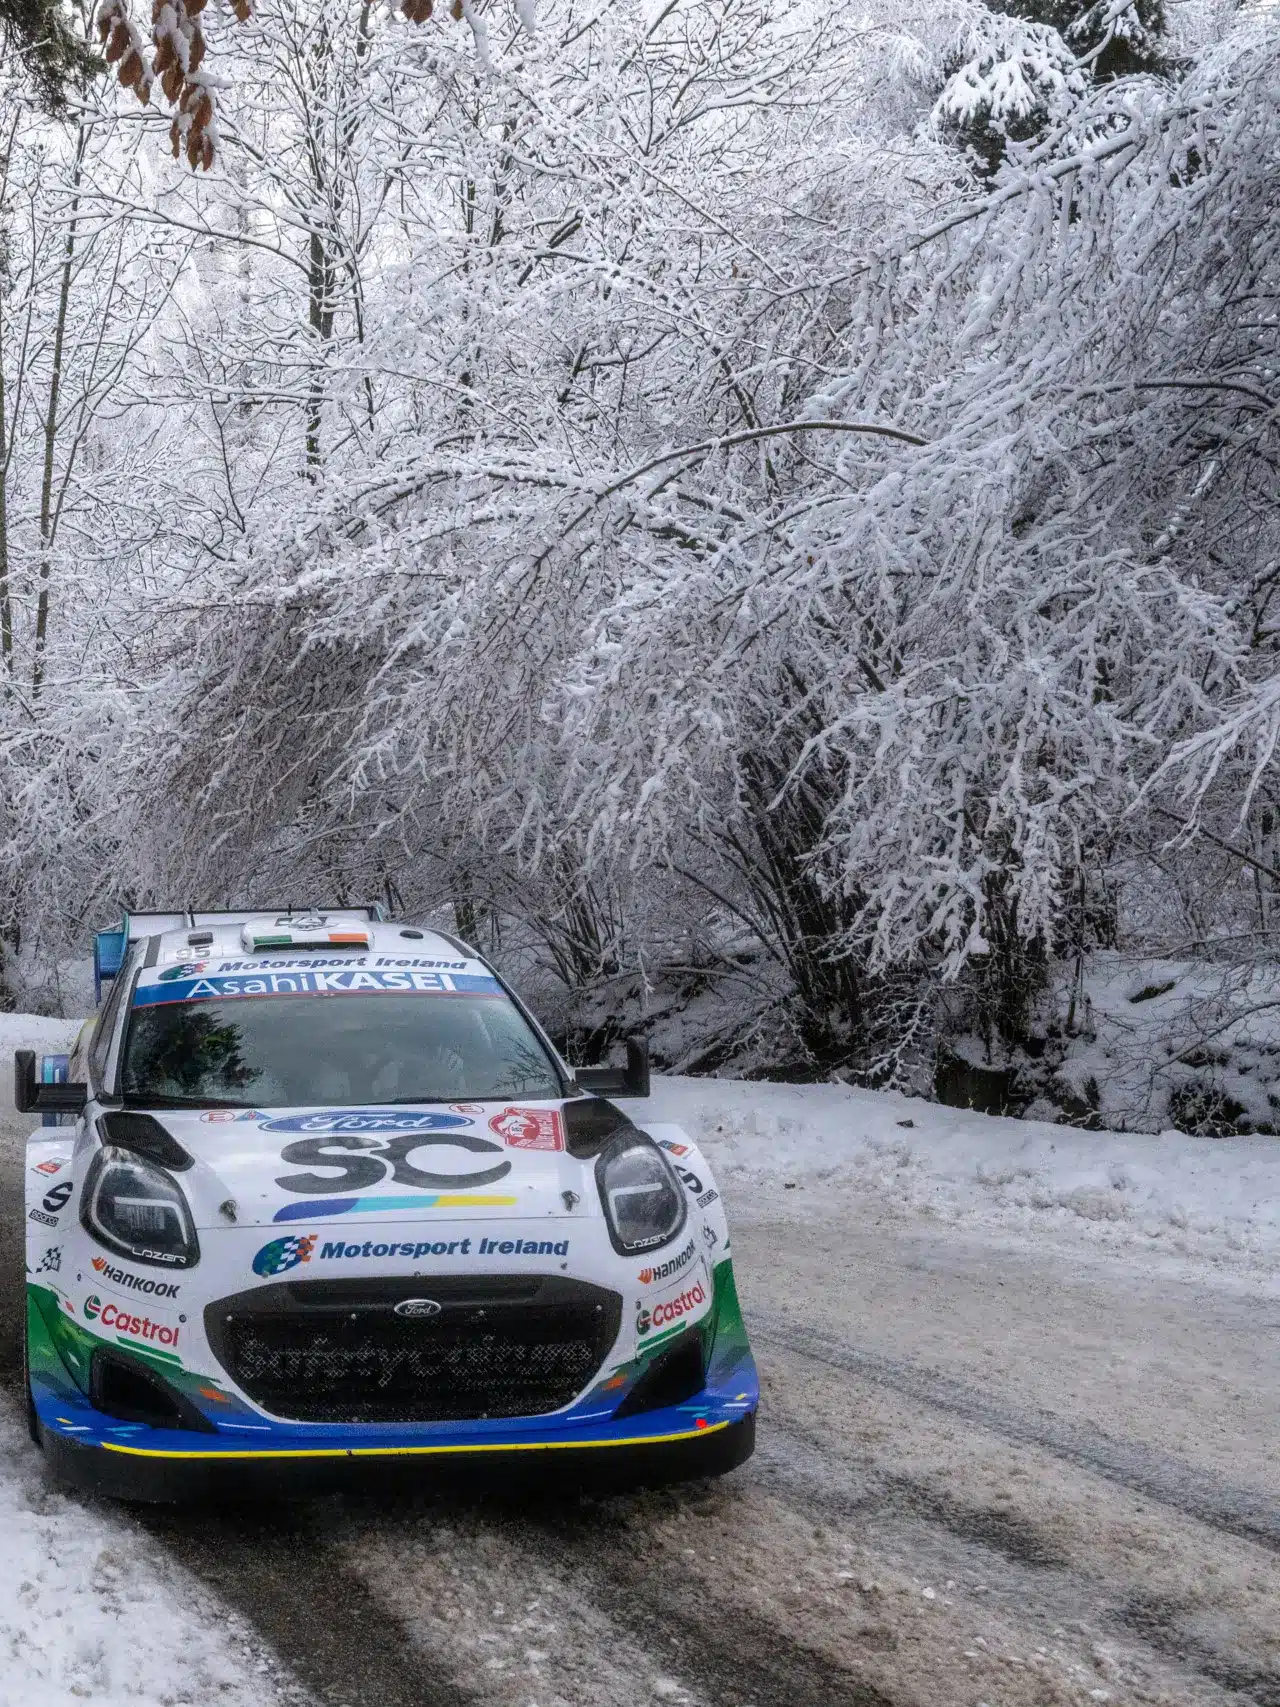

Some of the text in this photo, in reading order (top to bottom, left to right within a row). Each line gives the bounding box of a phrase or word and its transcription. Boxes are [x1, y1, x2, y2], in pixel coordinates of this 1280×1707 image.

[176, 946, 210, 960] 95
[218, 957, 467, 972] Motorsport Ireland
[300, 1113, 431, 1130] Ford
[275, 1133, 512, 1194] SC
[320, 1238, 569, 1259] Motorsport Ireland
[404, 1303, 432, 1315] Ford
[653, 1279, 705, 1326] Castrol
[101, 1304, 179, 1347] Castrol
